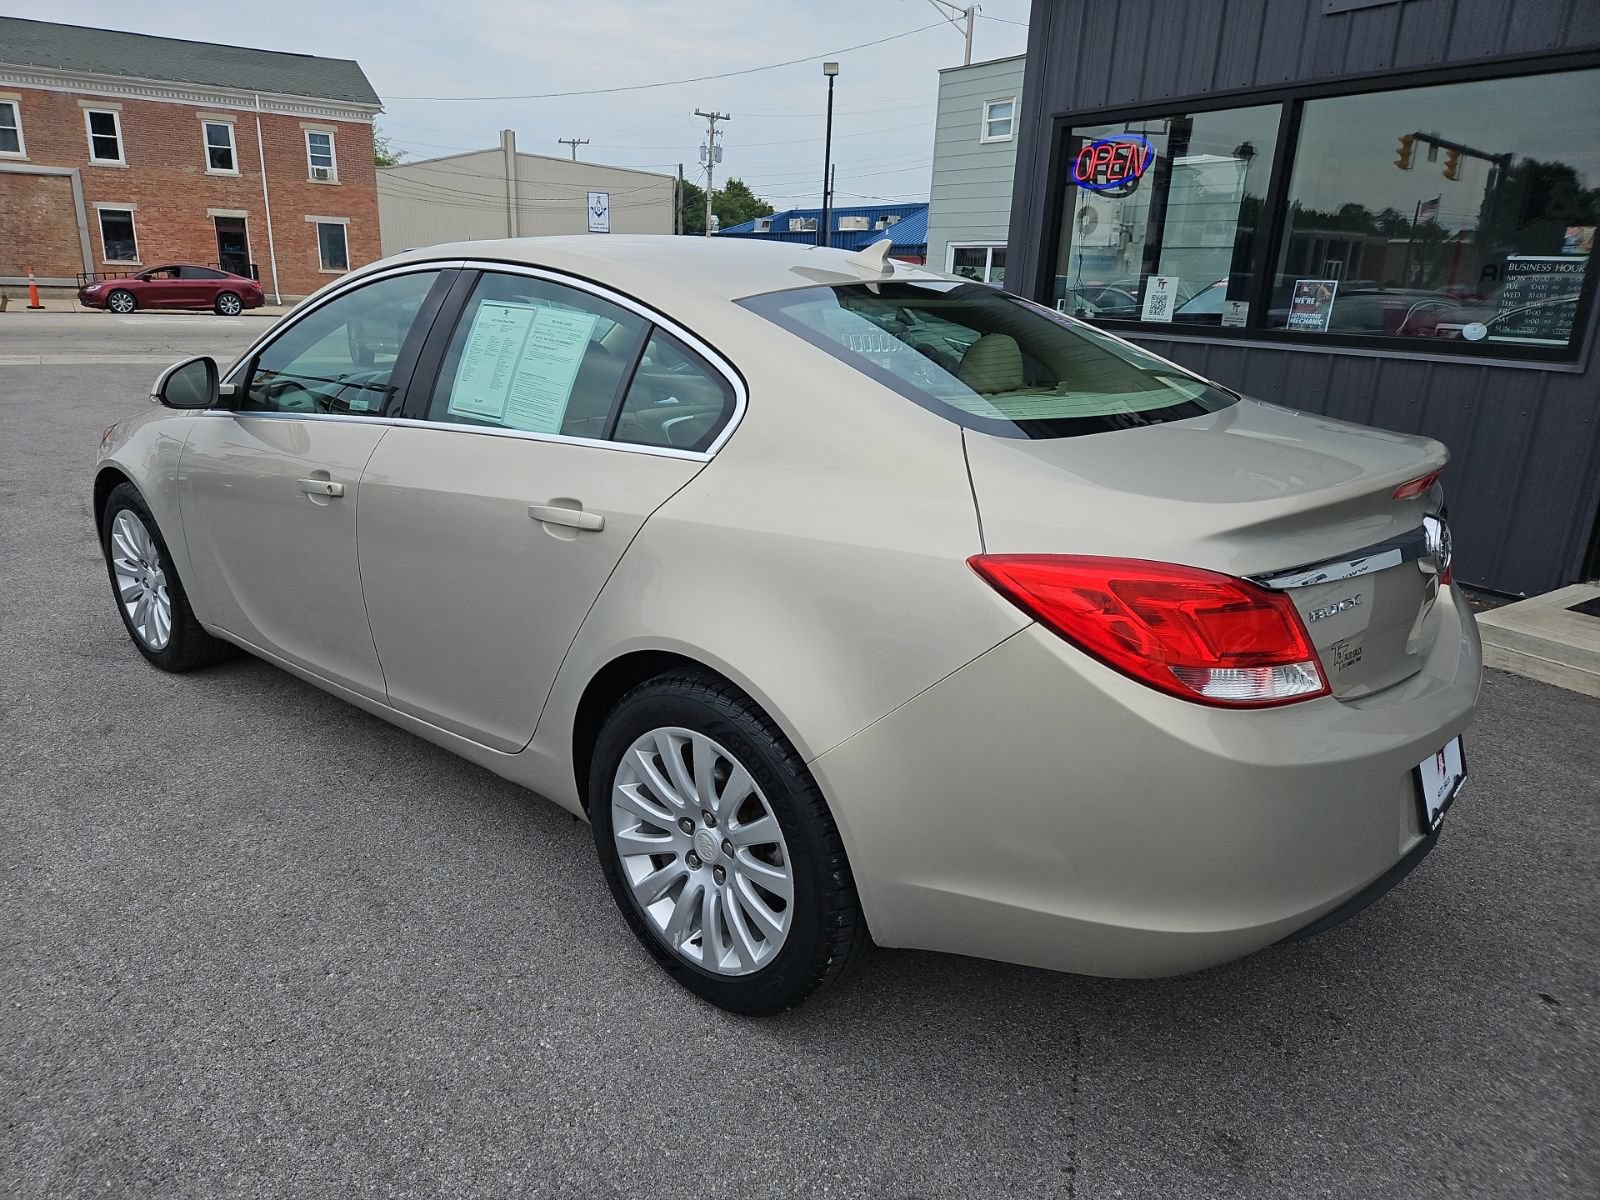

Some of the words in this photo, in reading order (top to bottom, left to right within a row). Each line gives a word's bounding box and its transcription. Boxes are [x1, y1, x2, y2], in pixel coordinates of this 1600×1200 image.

[1075, 143, 1148, 180] OPEN
[1508, 263, 1552, 272] BUSINESS
[1309, 594, 1361, 623] BUICK
